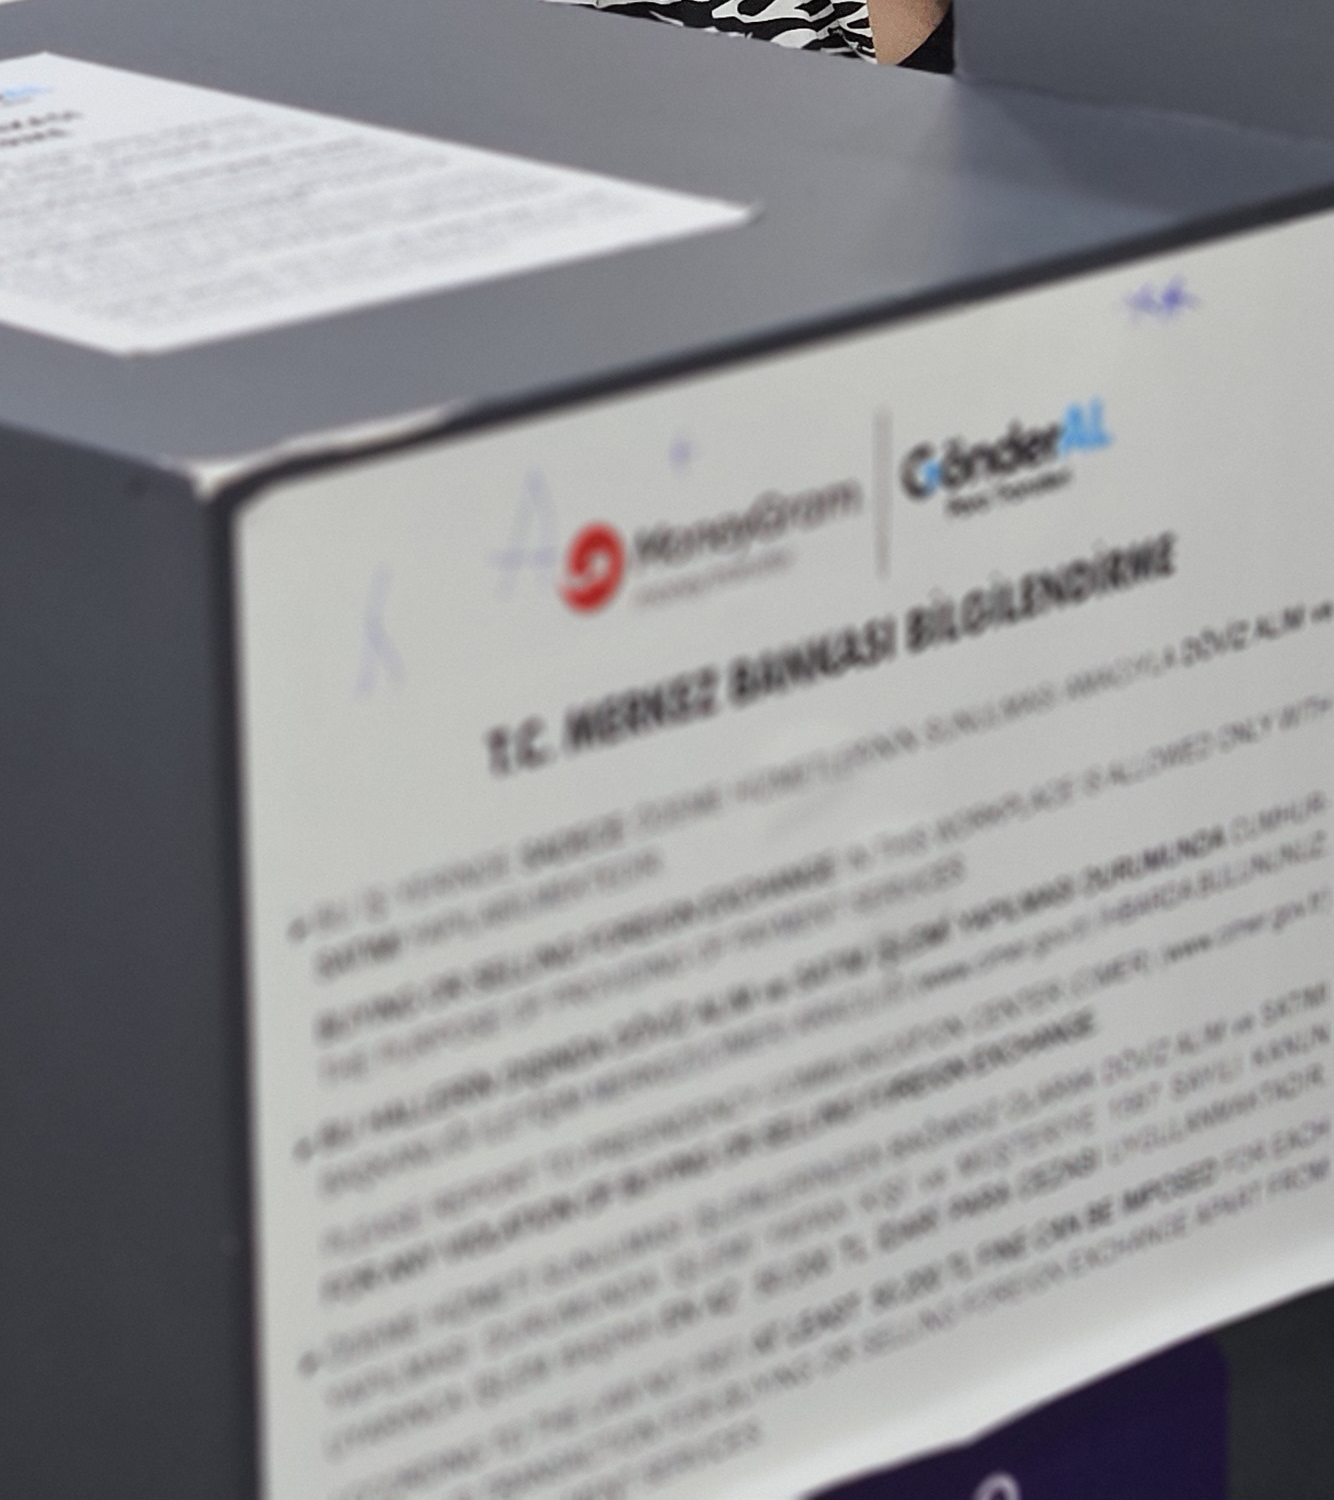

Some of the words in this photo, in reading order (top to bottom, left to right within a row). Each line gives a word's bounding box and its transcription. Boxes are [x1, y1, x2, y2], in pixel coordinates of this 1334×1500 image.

[564, 664, 722, 756] MERKEZ
[727, 612, 898, 709] BANKASI
[904, 530, 1176, 654] BİLGİLENDİRME
